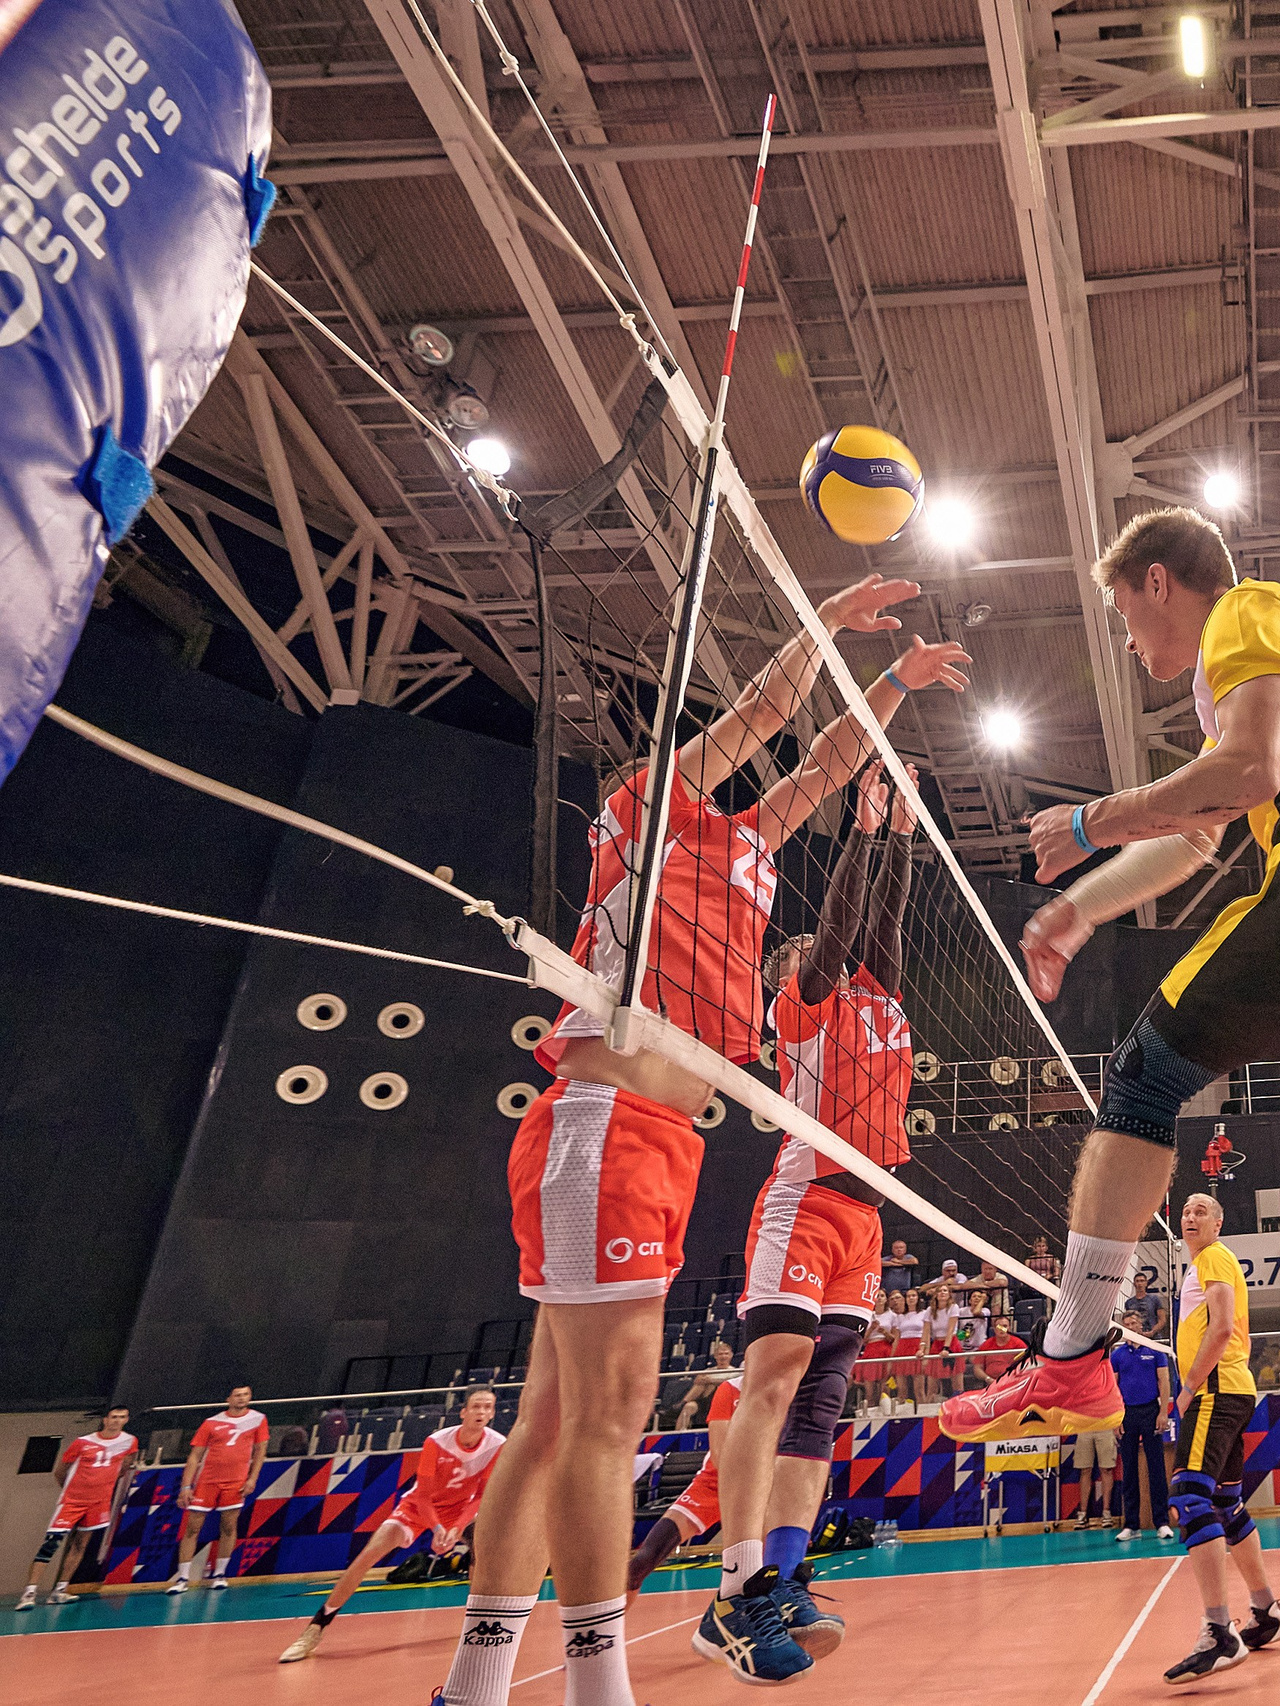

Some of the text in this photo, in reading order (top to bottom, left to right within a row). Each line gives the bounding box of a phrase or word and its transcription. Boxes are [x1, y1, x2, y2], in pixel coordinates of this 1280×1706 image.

[24, 86, 182, 285] sports
[870, 464, 893, 474] FIVB
[859, 1005, 911, 1054] 12
[226, 1428, 242, 1447] 7
[92, 1450, 113, 1468] 11
[445, 1467, 467, 1489] 2
[463, 1635, 514, 1648] Kappa
[566, 1639, 615, 1659] Kappa
